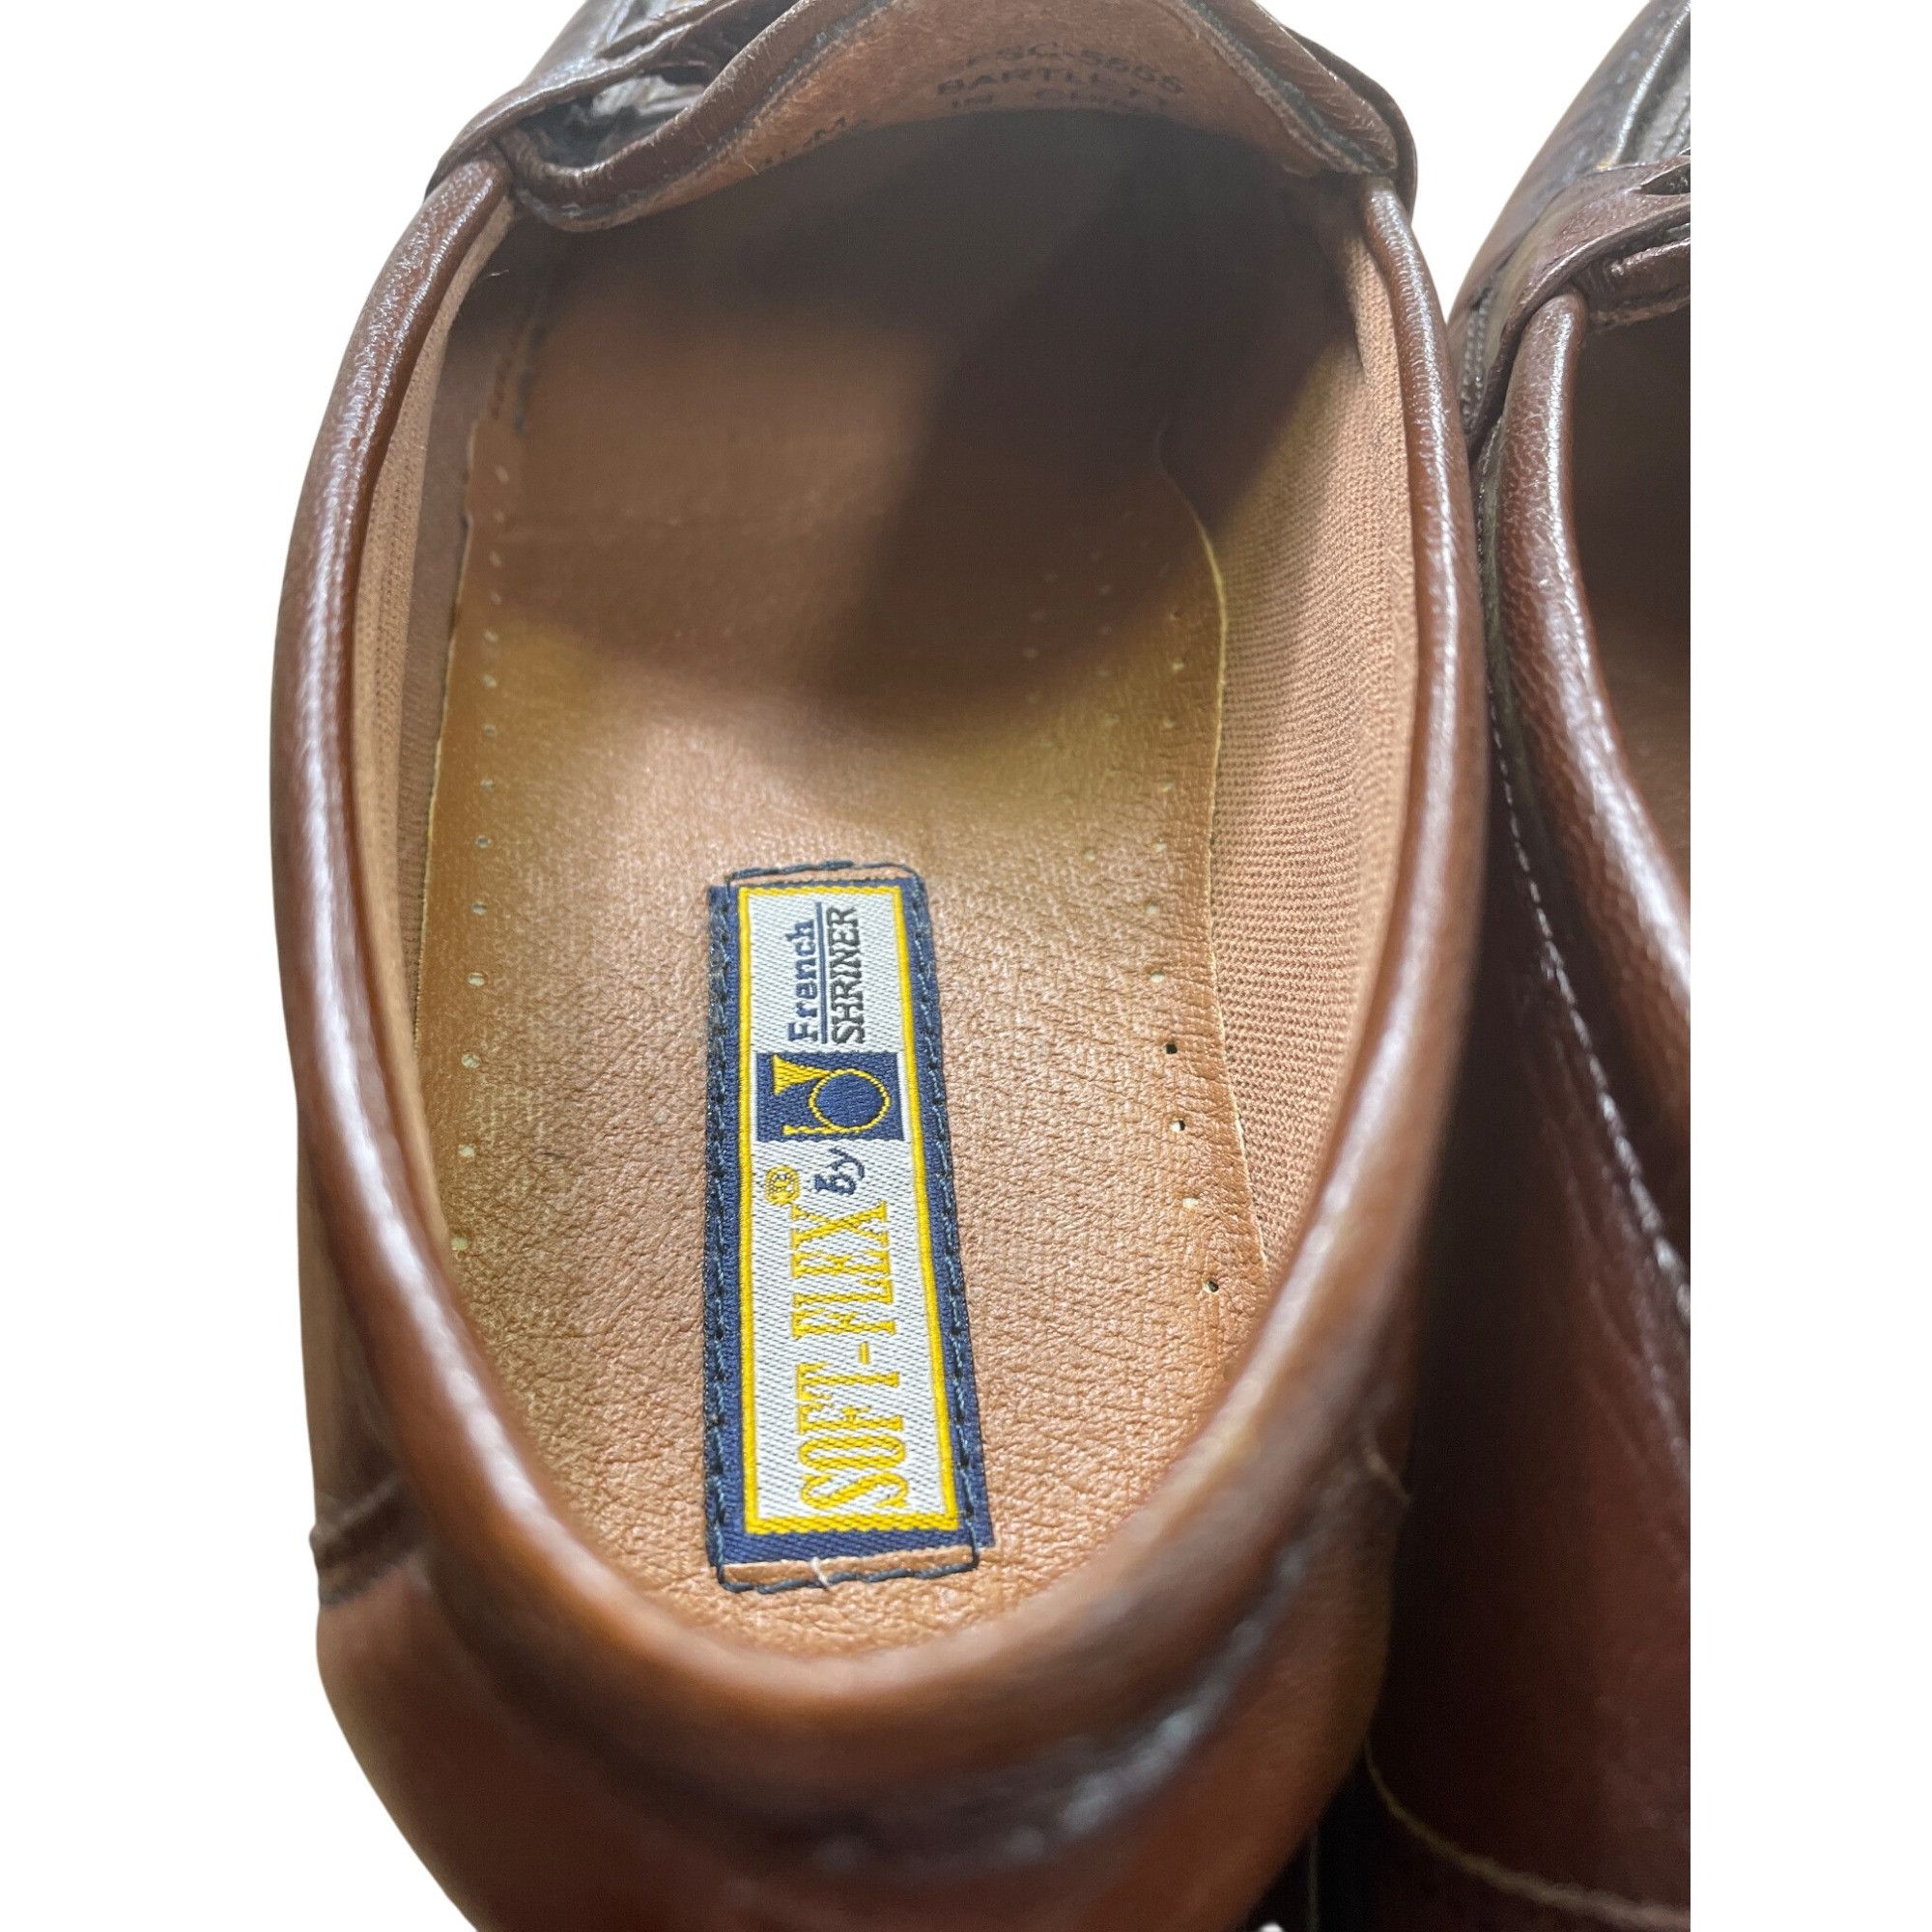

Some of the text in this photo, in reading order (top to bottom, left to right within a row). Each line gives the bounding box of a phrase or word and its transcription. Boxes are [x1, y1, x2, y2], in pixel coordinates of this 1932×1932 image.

[785, 918, 819, 1042] French
[825, 905, 866, 1045] SHRINER
[813, 1147, 866, 1197] by
